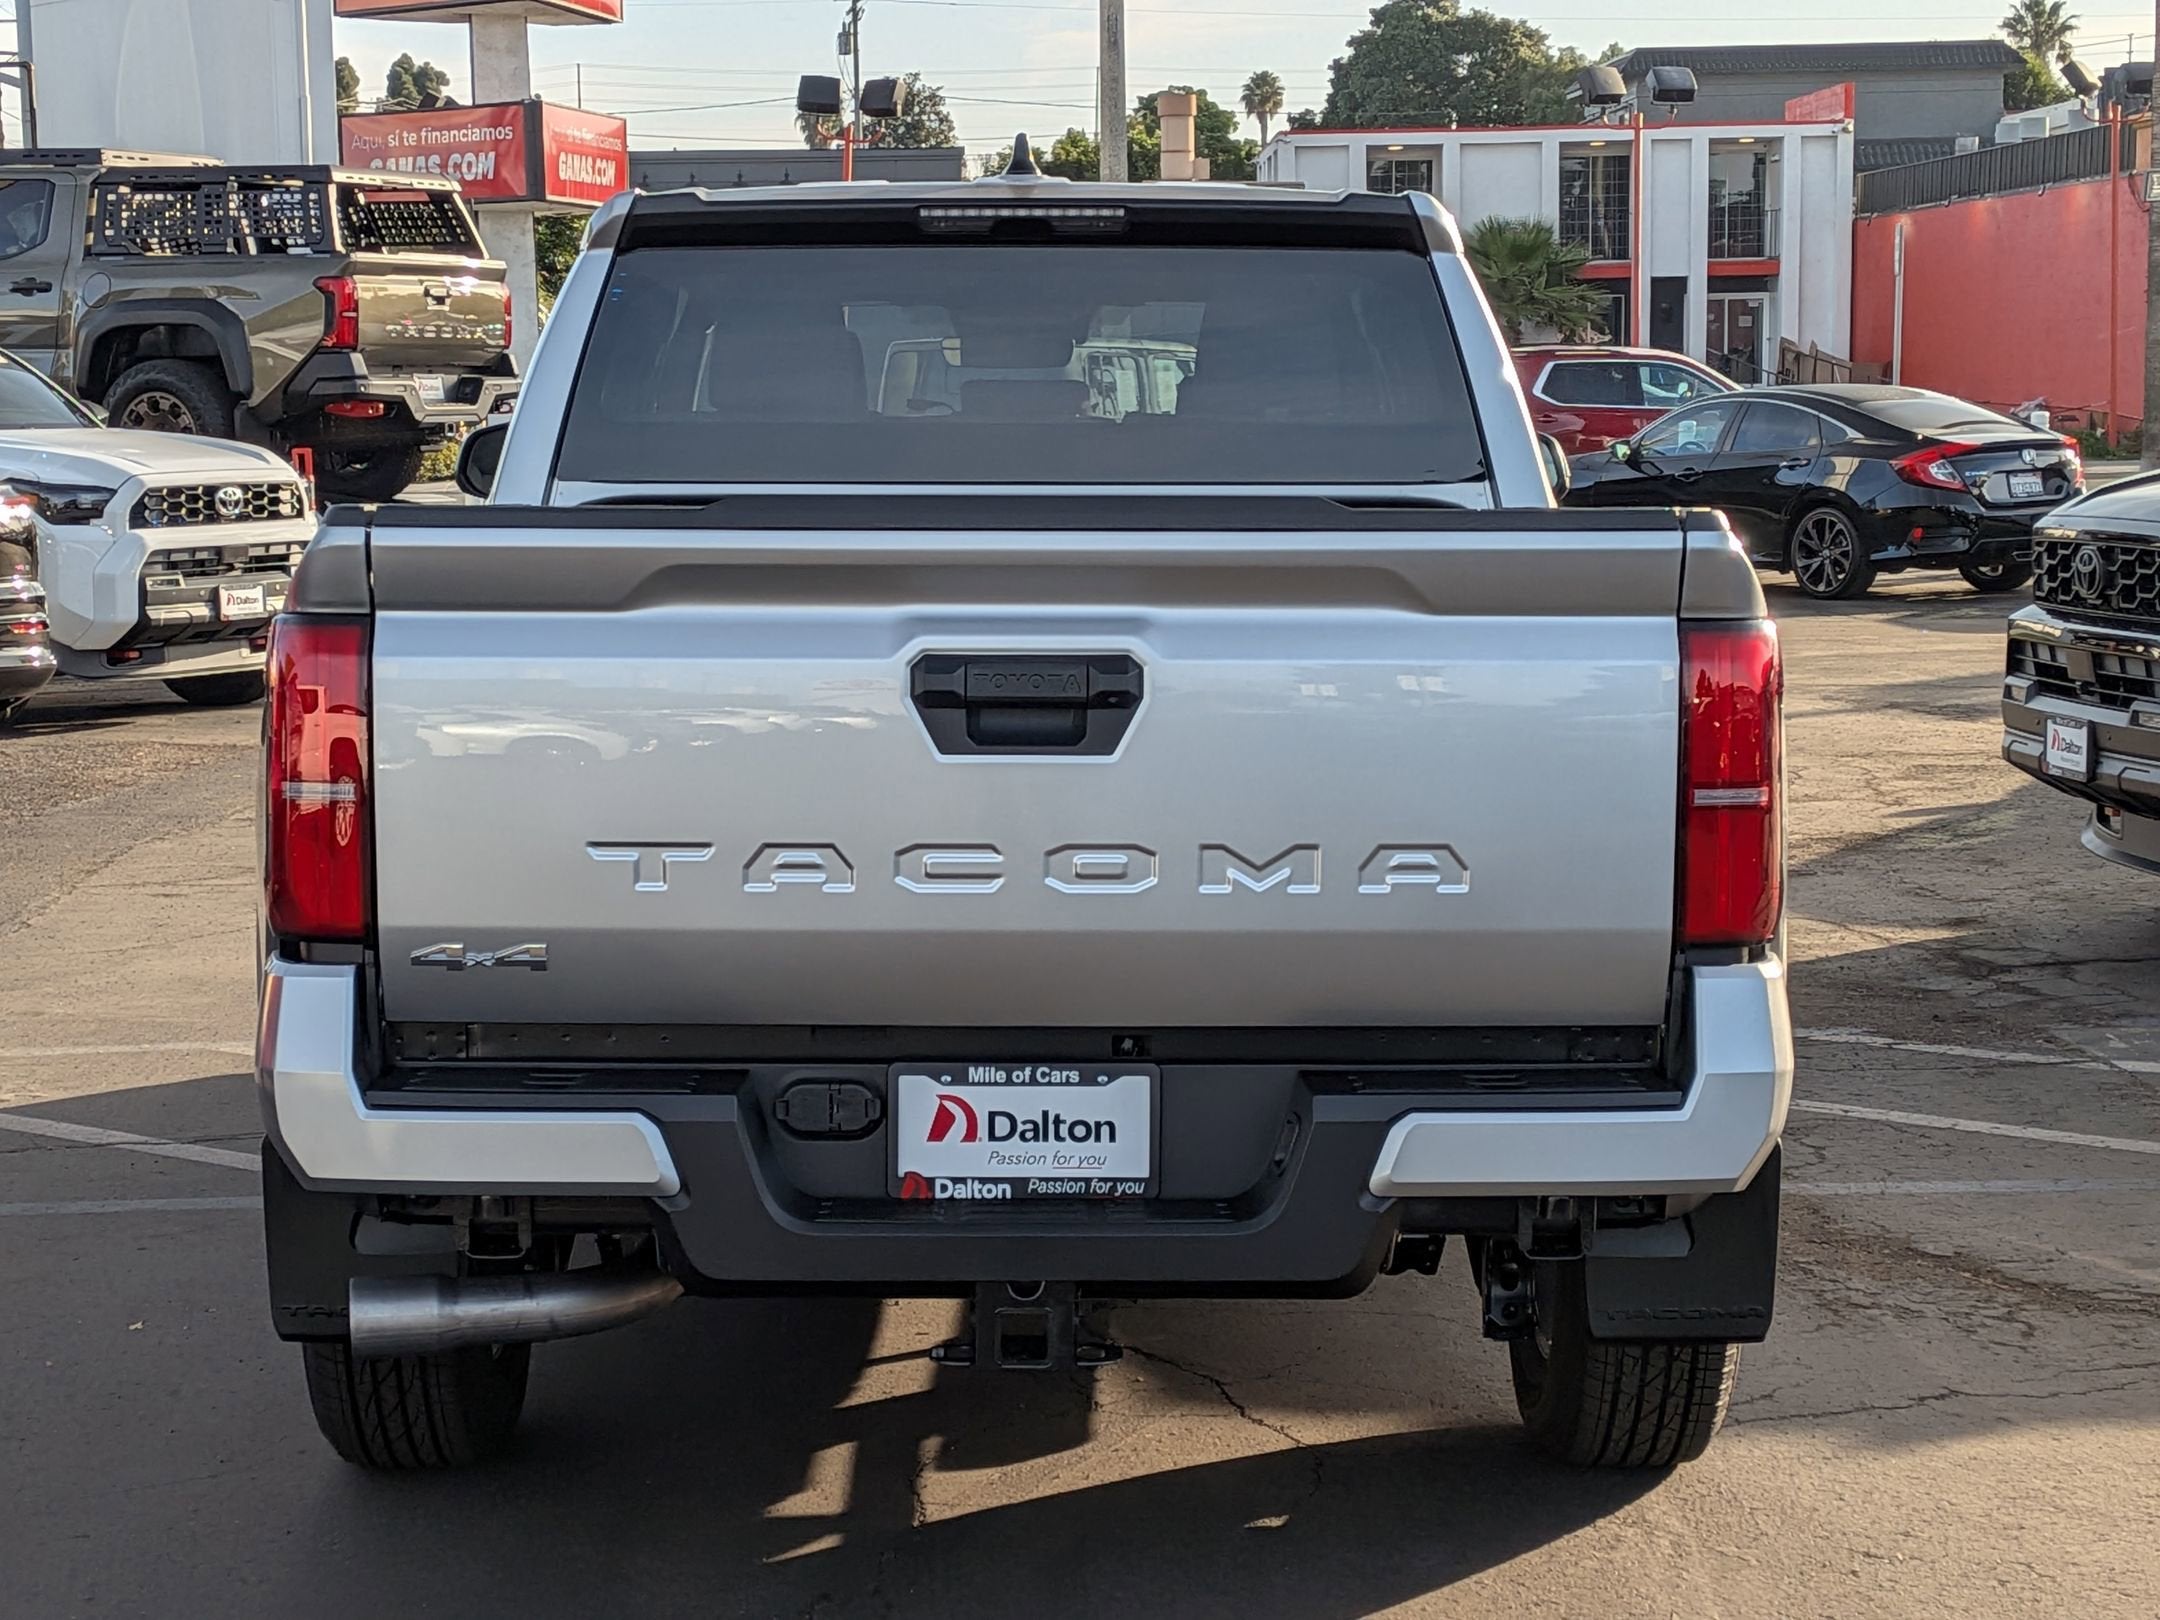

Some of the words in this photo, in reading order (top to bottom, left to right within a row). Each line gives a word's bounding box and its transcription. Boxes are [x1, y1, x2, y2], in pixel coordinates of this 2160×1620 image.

[387, 129, 400, 147] sí
[402, 130, 417, 146] te
[420, 123, 513, 145] financiamos
[558, 151, 617, 187] GANAS.COM
[972, 673, 1082, 693] TOYOTA
[586, 840, 1473, 895] TACOMA
[968, 1066, 1006, 1083] Mile
[1011, 1066, 1033, 1083] of
[1036, 1066, 1080, 1083] Cars
[987, 1109, 1117, 1143] Dalton
[987, 1151, 1046, 1166] Passion
[1052, 1150, 1076, 1166] for
[1078, 1153, 1108, 1168] you
[934, 1179, 1012, 1200] Dalton
[1027, 1178, 1087, 1194] Passion
[1090, 1178, 1114, 1195] for
[1115, 1181, 1146, 1196] you
